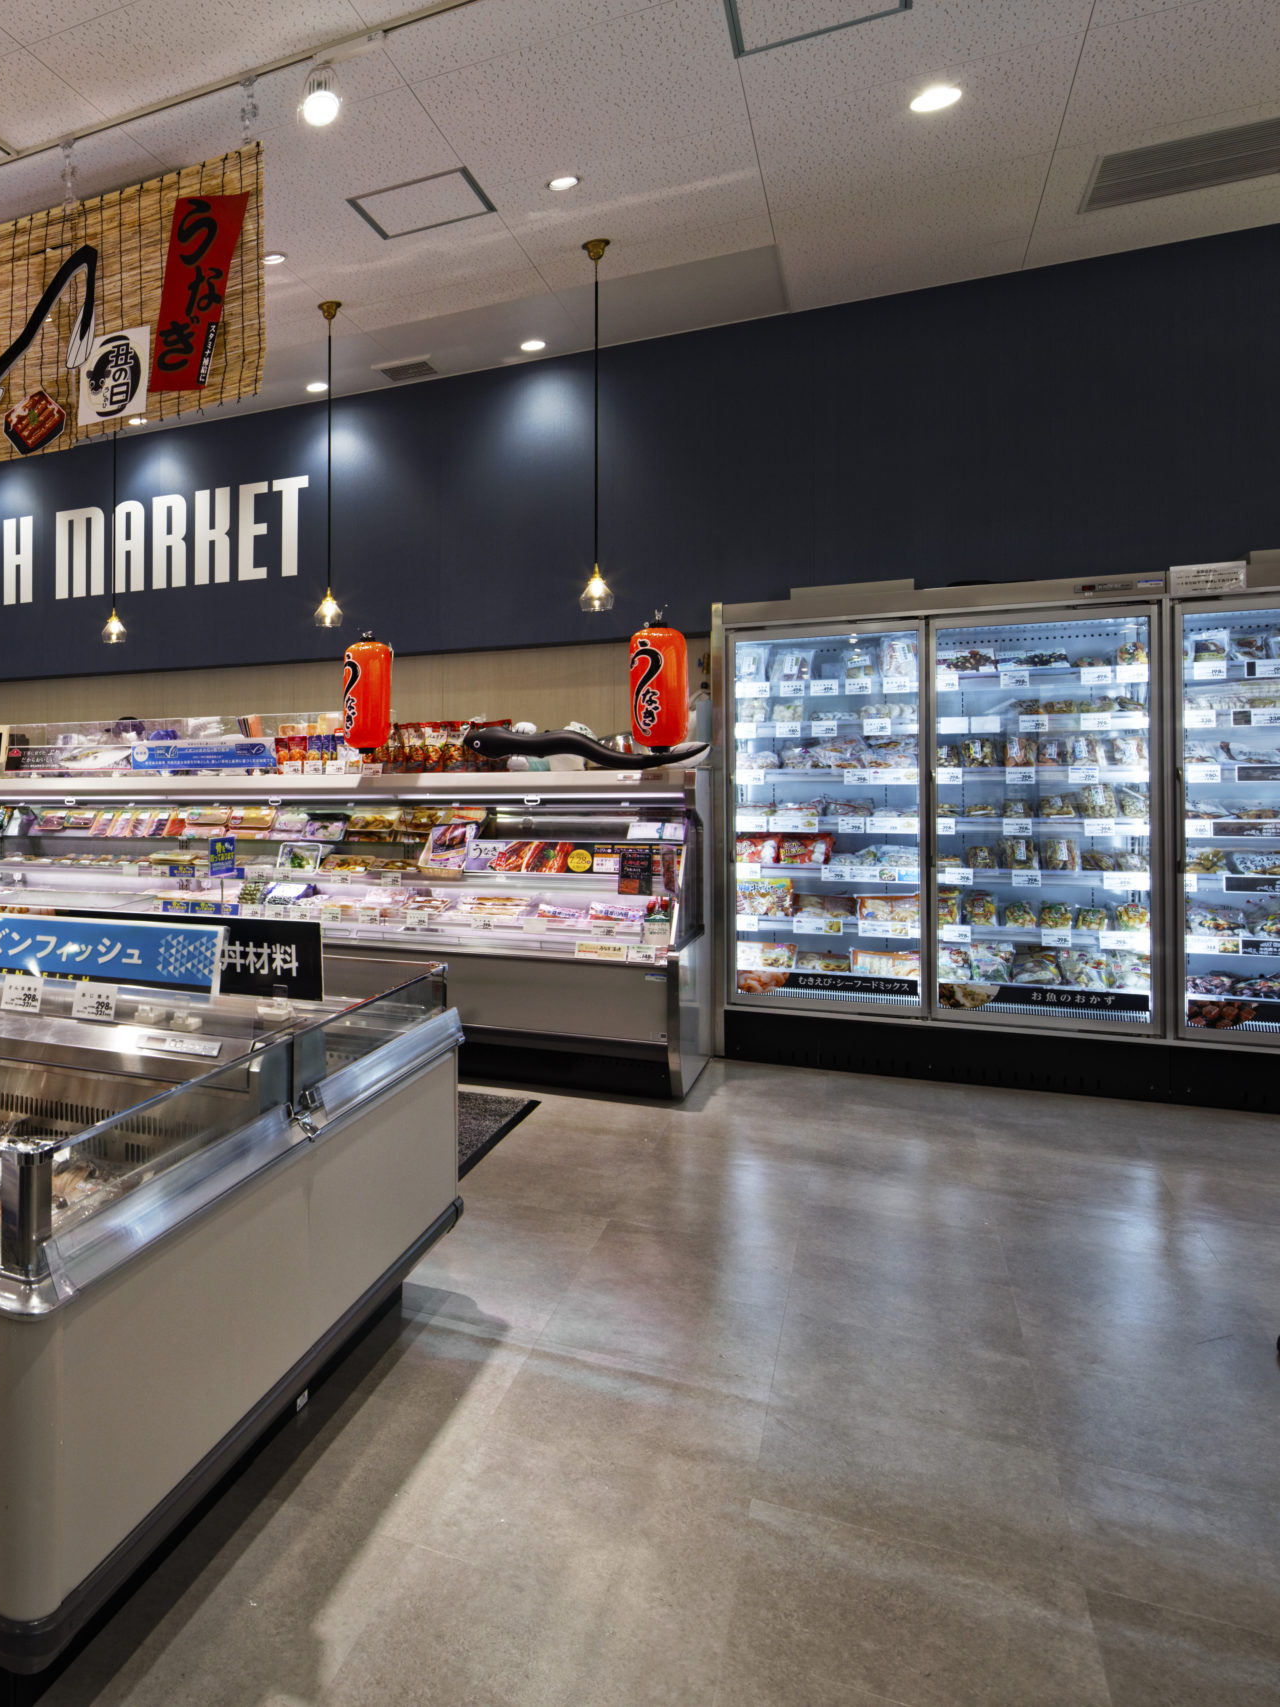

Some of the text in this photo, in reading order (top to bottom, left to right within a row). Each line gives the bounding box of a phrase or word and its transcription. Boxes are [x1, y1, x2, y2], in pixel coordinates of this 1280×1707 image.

[157, 199, 223, 371] うなぎ
[109, 343, 134, 406] 丑の日
[55, 475, 309, 600] MARKET
[630, 638, 664, 736] うなぎ
[473, 843, 498, 860] うなぎ
[221, 941, 298, 977] 丼材料
[798, 976, 910, 991] むきえび・シーフードミックス
[1031, 991, 1116, 1005] お魚のおかず
